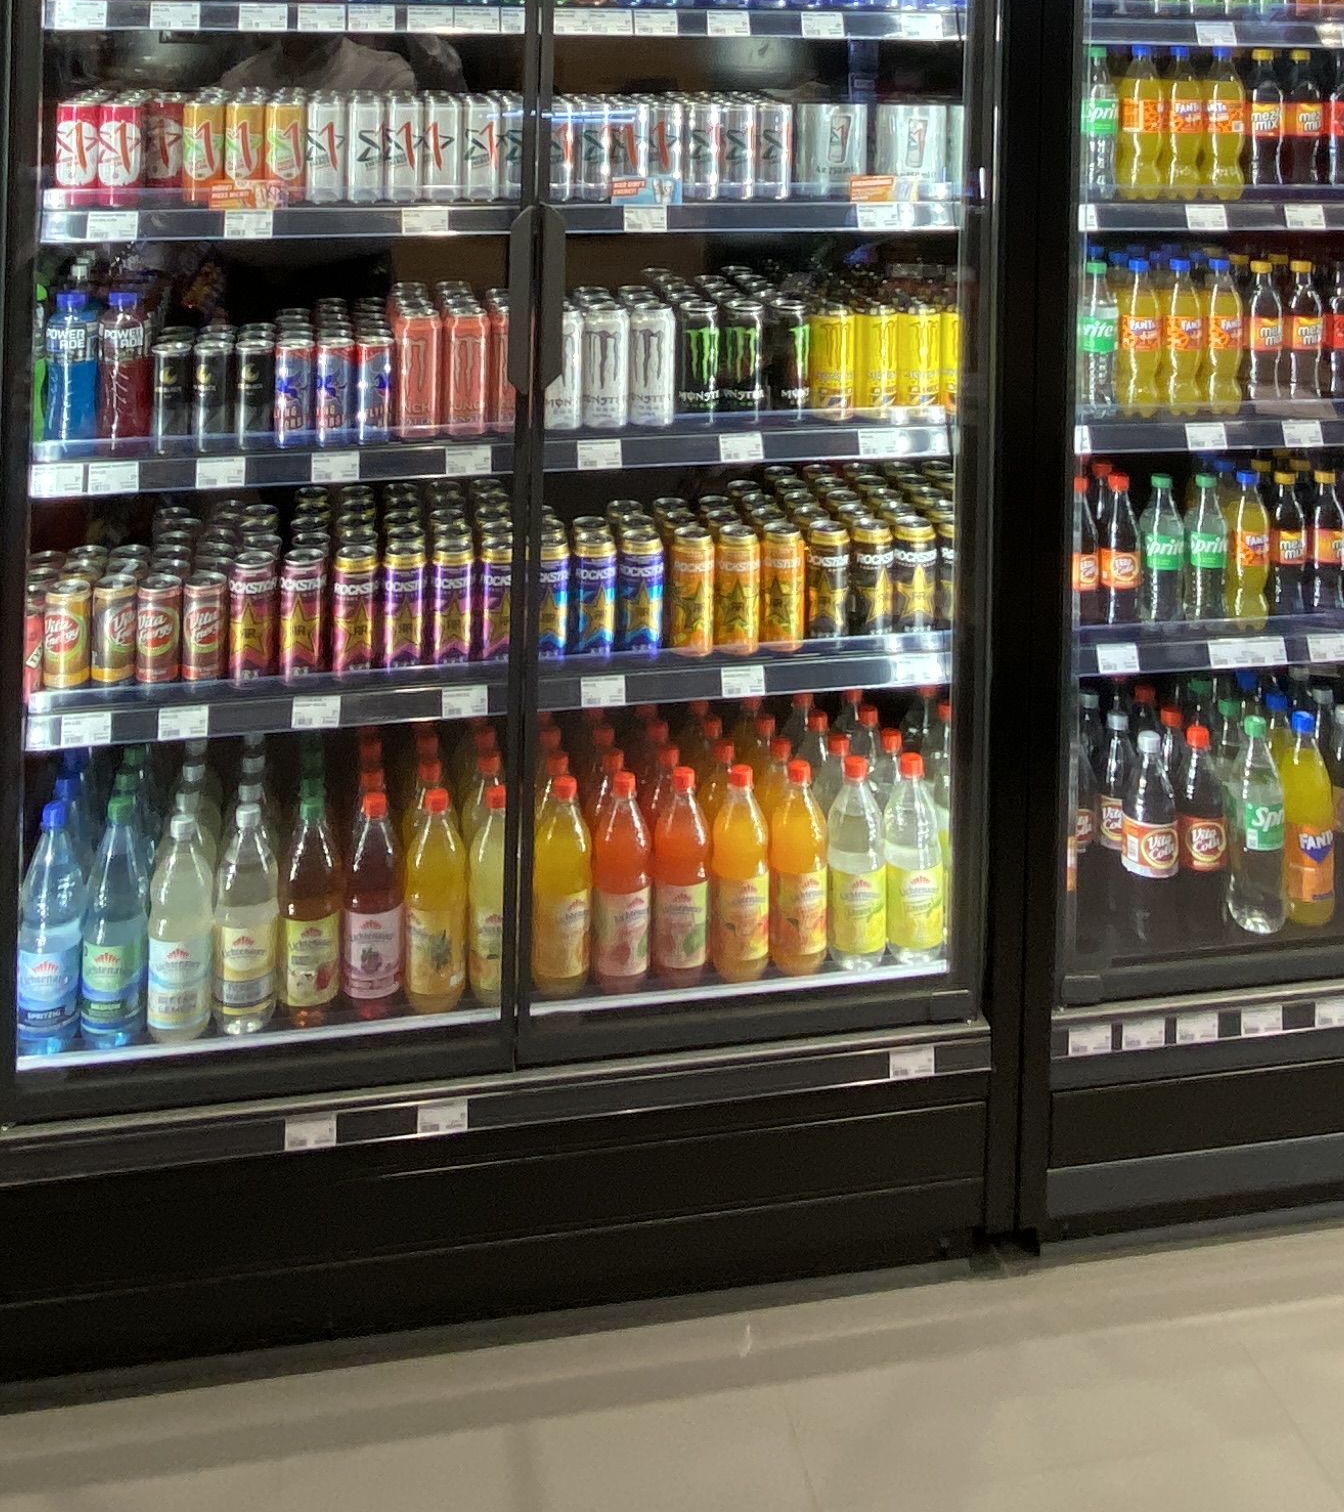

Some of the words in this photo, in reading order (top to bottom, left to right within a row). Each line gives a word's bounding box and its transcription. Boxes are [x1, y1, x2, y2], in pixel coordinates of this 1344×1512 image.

[1148, 834, 1173, 849] Vita
[1192, 827, 1217, 842] Vita
[1192, 838, 1221, 853] Cola
[1149, 846, 1175, 861] Cola
